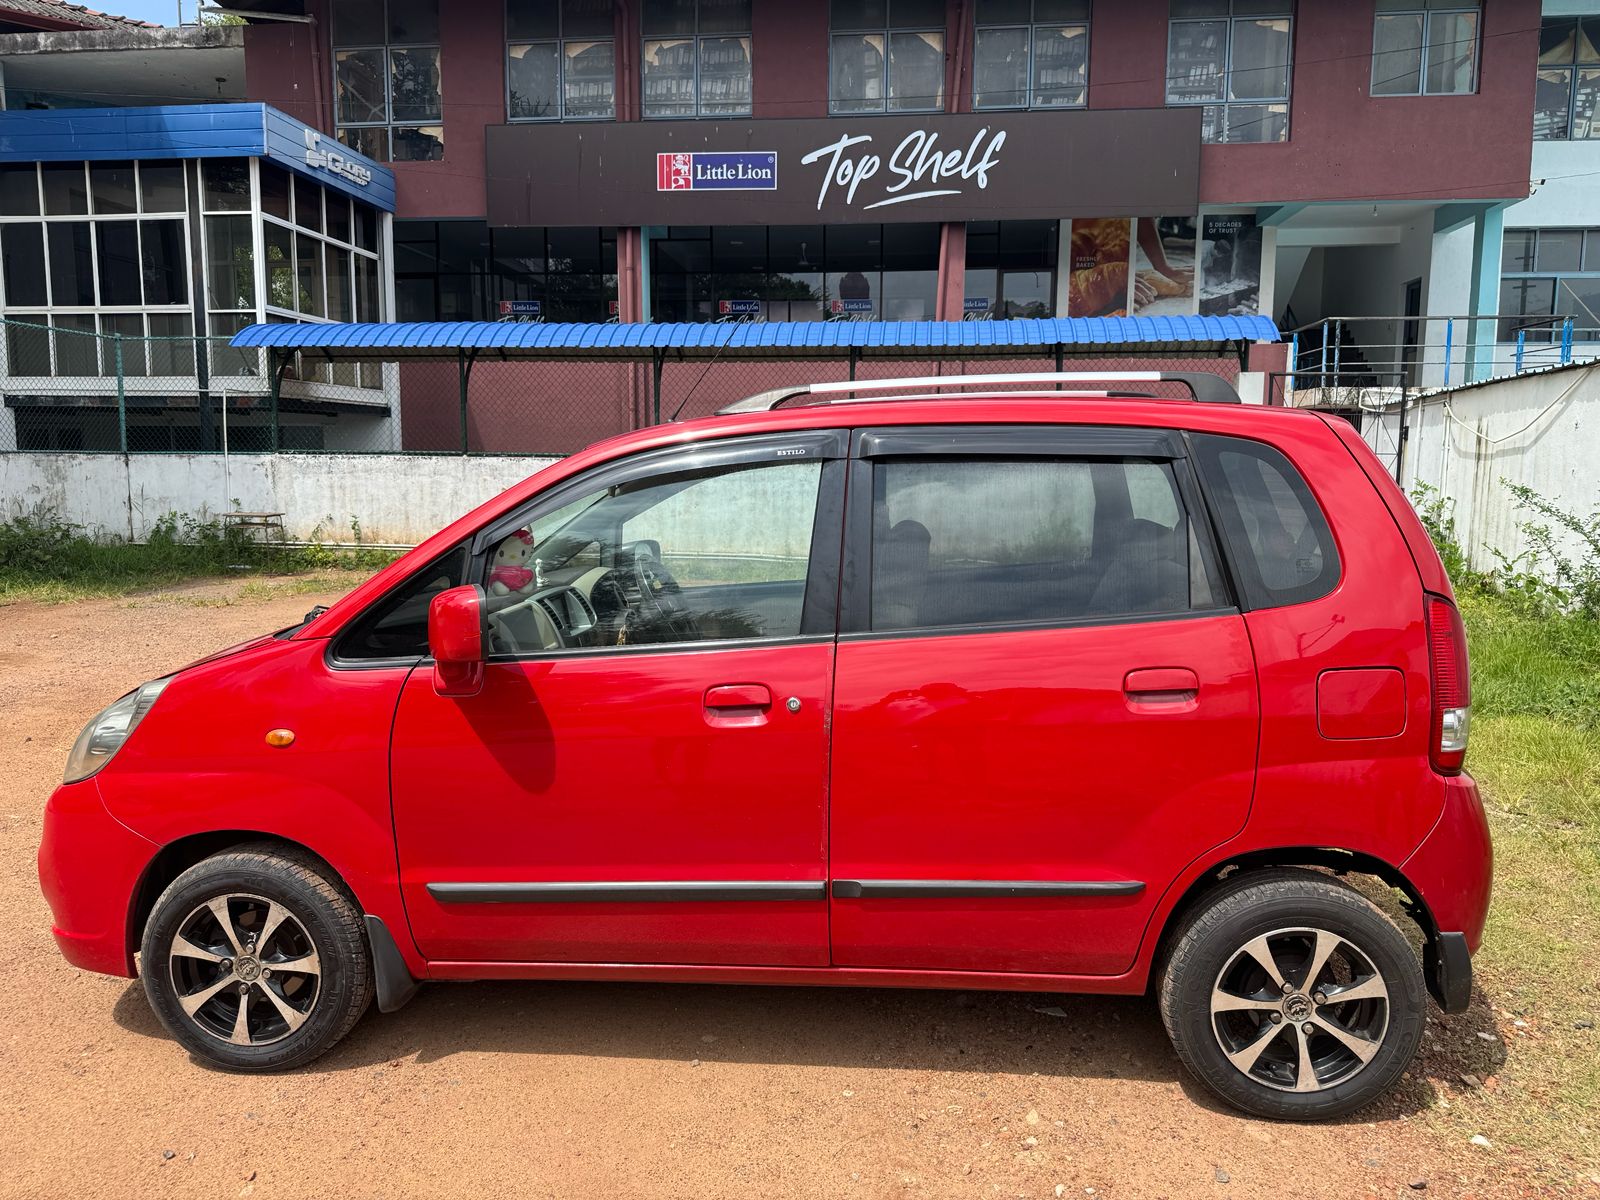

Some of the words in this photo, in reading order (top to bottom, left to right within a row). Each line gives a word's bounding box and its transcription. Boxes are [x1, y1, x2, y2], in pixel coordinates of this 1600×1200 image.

[696, 163, 736, 180] Little
[737, 163, 772, 179] Lion
[801, 133, 881, 210] Top
[886, 128, 1007, 193] Shelf
